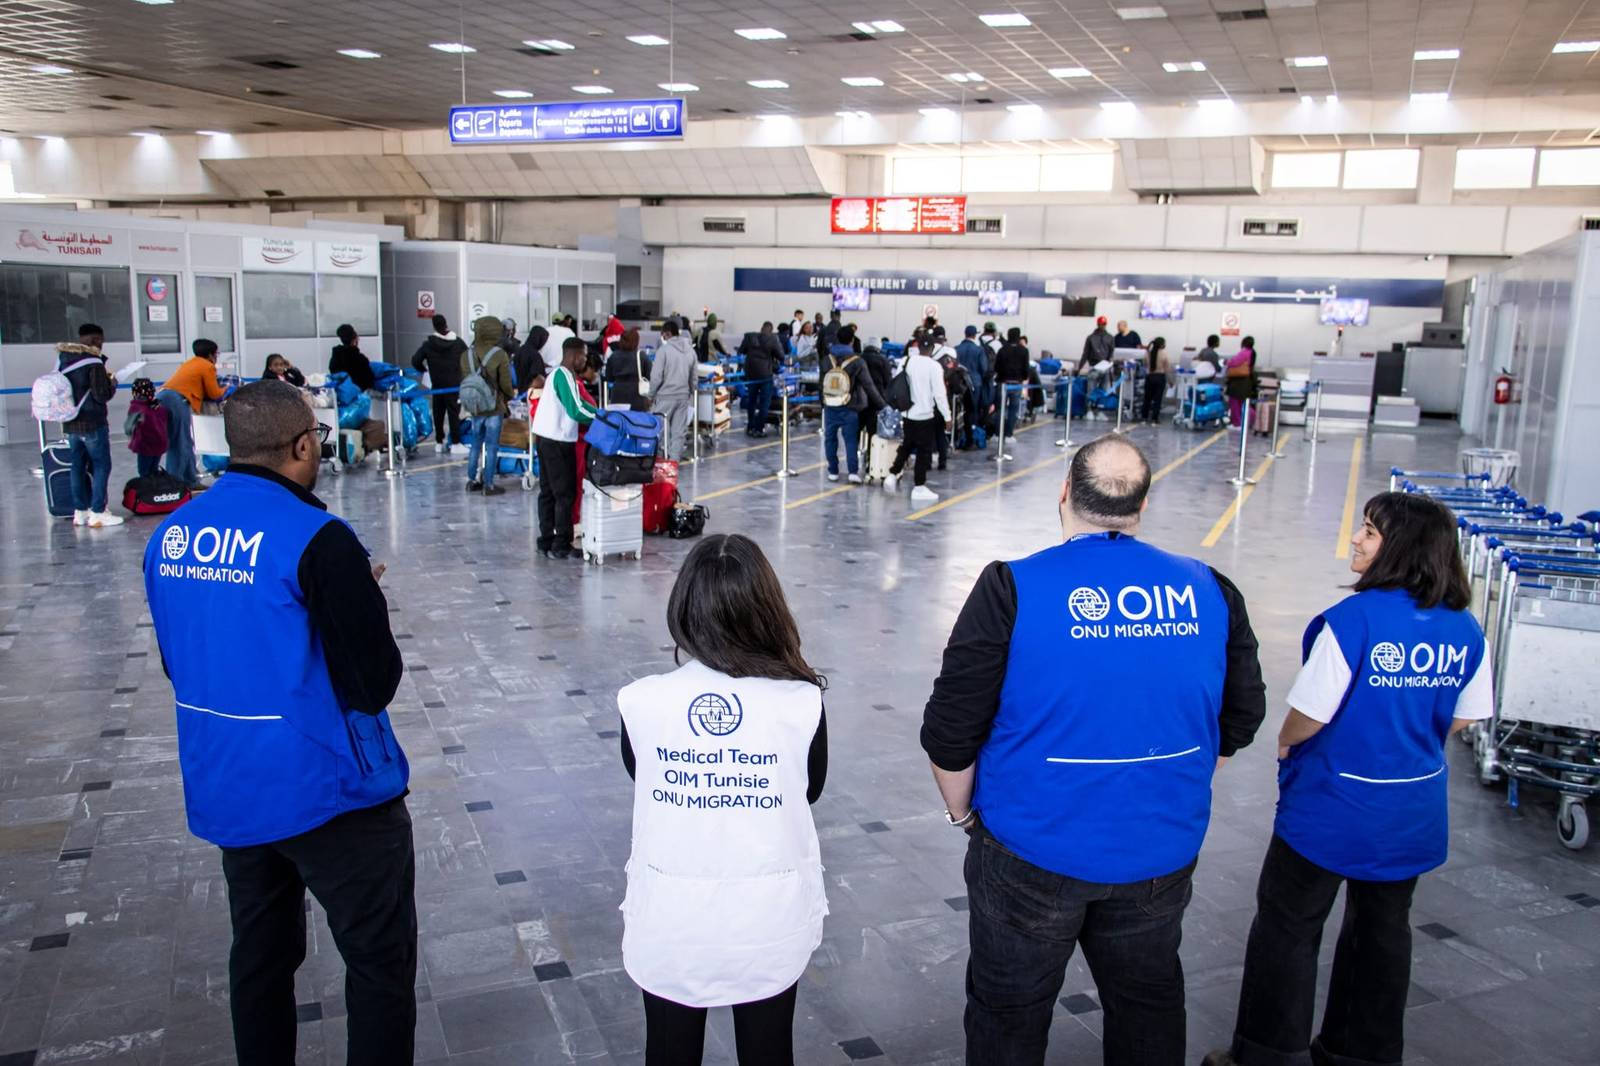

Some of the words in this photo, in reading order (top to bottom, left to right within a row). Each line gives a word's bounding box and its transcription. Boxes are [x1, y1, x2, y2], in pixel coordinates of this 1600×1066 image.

[57, 245, 102, 256] TUNISAIR
[809, 276, 907, 290] ENREGISTREMENT
[917, 278, 939, 291] DES
[950, 280, 1004, 292] BAGAGES
[193, 526, 265, 567] OIM
[160, 563, 183, 578] ONU
[187, 565, 255, 585] MIGRATION
[1117, 585, 1198, 621] OIM
[1071, 624, 1110, 639] ONU
[1114, 622, 1199, 638] MIGRATION
[1410, 642, 1468, 675] OIM
[1368, 674, 1402, 688] ONU
[656, 747, 723, 764] Medical
[728, 748, 778, 765] Team
[664, 769, 698, 788] OIM
[703, 772, 770, 789] Tunisie
[653, 789, 684, 807] ONU
[687, 794, 783, 809] MIGRATION
